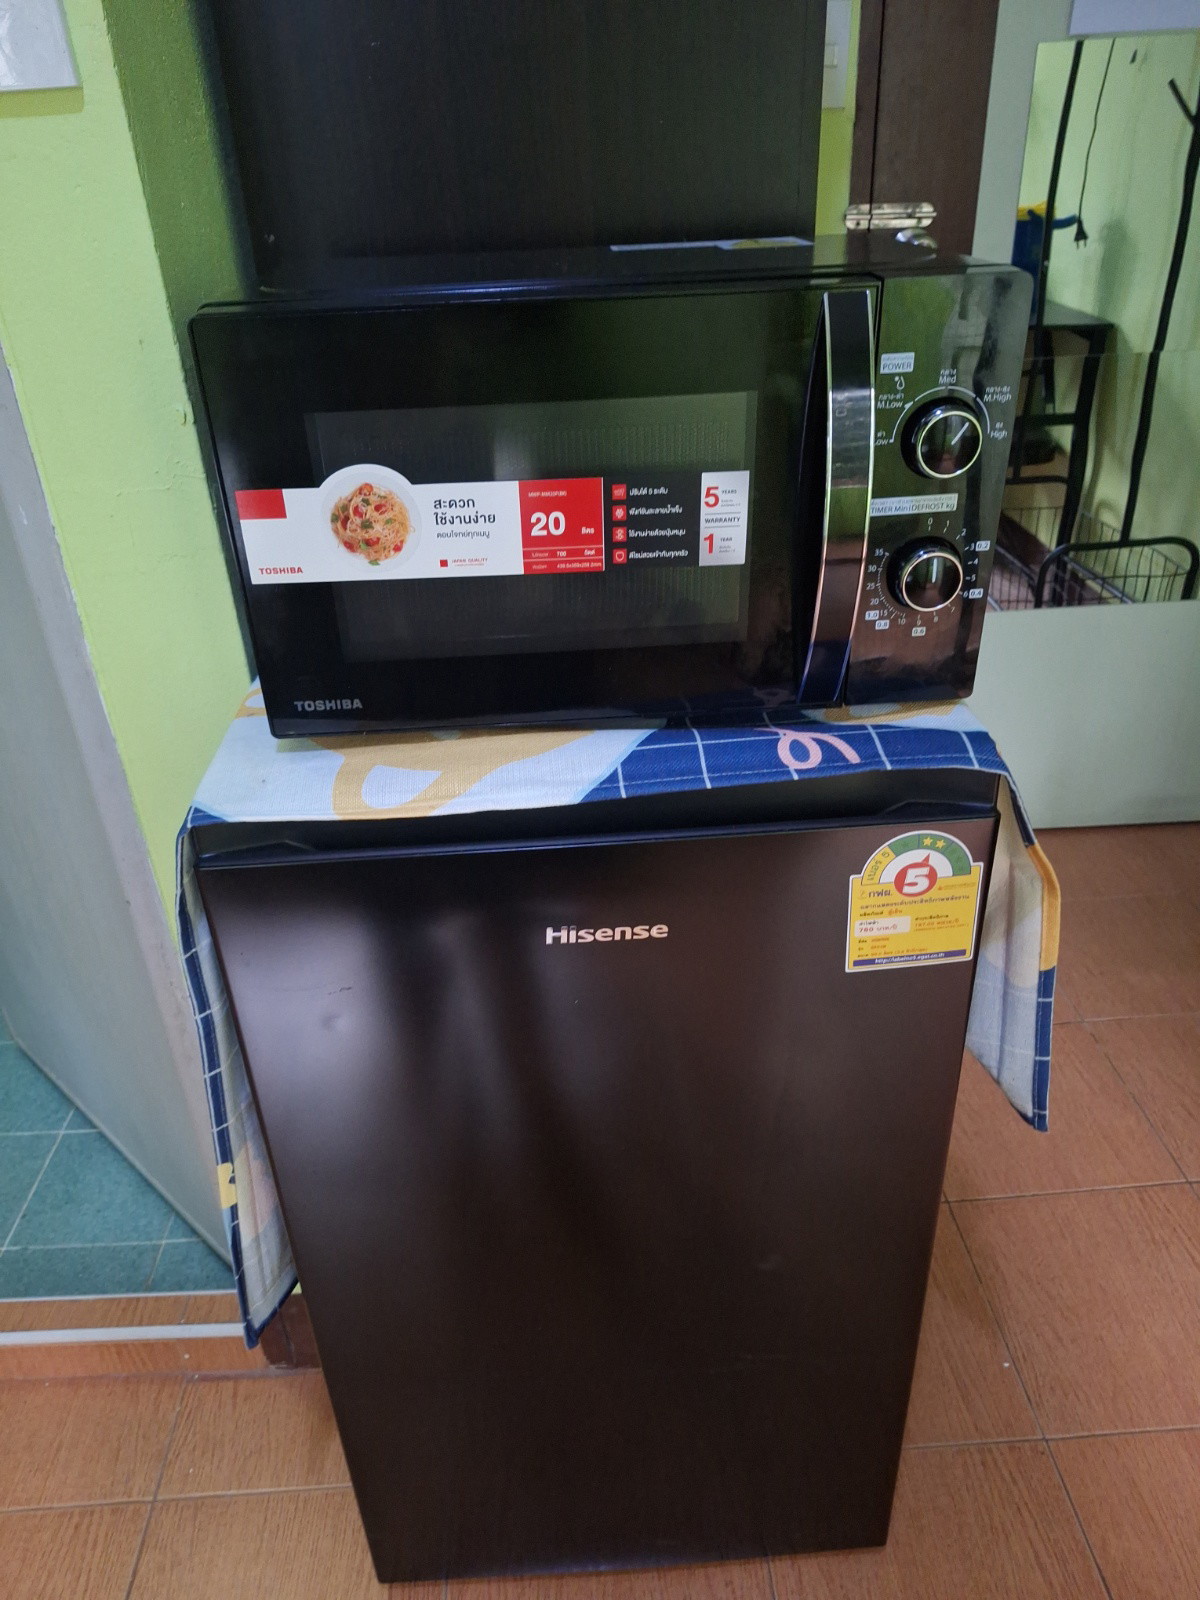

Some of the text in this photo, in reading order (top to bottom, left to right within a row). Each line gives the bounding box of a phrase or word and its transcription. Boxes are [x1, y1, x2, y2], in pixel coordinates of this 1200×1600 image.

[882, 360, 912, 371] POWER
[938, 375, 957, 385] Med
[983, 393, 1012, 403] M.High
[877, 401, 903, 409] M.Low
[990, 430, 1008, 440] High
[704, 486, 720, 508] 5
[434, 498, 475, 510] สะดวก
[871, 505, 894, 514] TIMER
[434, 511, 496, 526] ใช้งานง่าย
[530, 511, 566, 536] 20
[704, 516, 741, 524] WARRANTY
[927, 517, 933, 525] 0
[436, 530, 490, 540] ตอบโจทย์ทุกเมนู
[703, 533, 714, 555] 1
[977, 542, 989, 550] 0.2
[874, 548, 884, 556] 35
[258, 566, 304, 575] TOSHIBA
[294, 698, 363, 712] TOSHIBA
[902, 866, 930, 895] 5
[546, 924, 669, 945] Hisense
